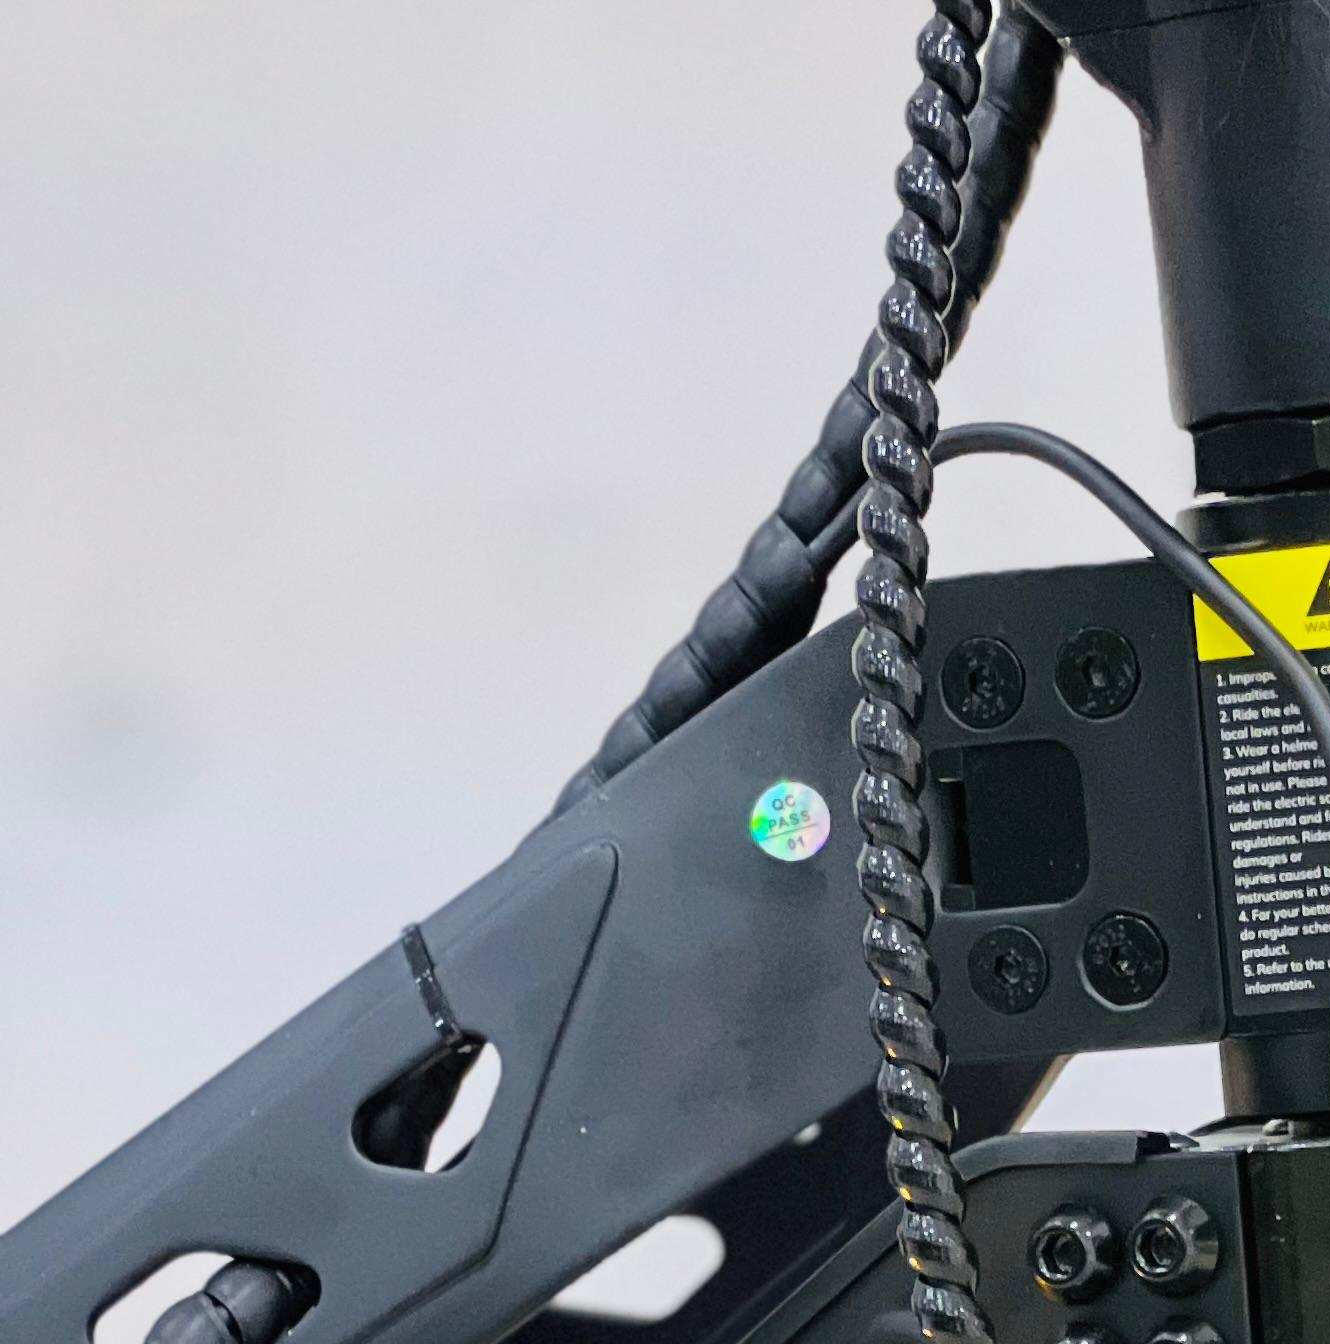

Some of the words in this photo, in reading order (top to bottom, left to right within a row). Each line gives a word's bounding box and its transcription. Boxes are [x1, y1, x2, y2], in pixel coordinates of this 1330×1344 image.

[1217, 674, 1226, 687] 1.
[1219, 710, 1230, 723] 2.
[1232, 708, 1258, 721] Ride
[1261, 706, 1280, 718] the
[1220, 725, 1248, 741] local
[1250, 725, 1278, 738] laws
[1281, 721, 1304, 734] and
[1236, 745, 1268, 757] Wear
[1271, 745, 1280, 754] a
[1282, 738, 1318, 753] helme
[1224, 761, 1270, 781] yourself
[1272, 758, 1310, 773] before
[1226, 784, 1245, 796] not
[1248, 782, 1259, 793] in
[1261, 781, 1286, 792] use.
[1287, 776, 1327, 789] Please
[1228, 800, 1250, 813] ride
[1252, 799, 1272, 811] the
[1275, 795, 1316, 809] electric
[768, 810, 810, 832] PASS
[1229, 814, 1296, 832] understand
[1299, 811, 1322, 825] and
[1233, 853, 1287, 868] damages
[1290, 852, 1302, 863] or
[1279, 864, 1321, 882] caused
[1306, 885, 1318, 897] in
[1239, 910, 1249, 922] 4.
[1272, 908, 1299, 922] your
[1240, 927, 1255, 940] do
[1258, 925, 1298, 940] regular
[1257, 962, 1288, 975] Refer
[1290, 961, 1303, 972] to
[1305, 958, 1325, 971] the
